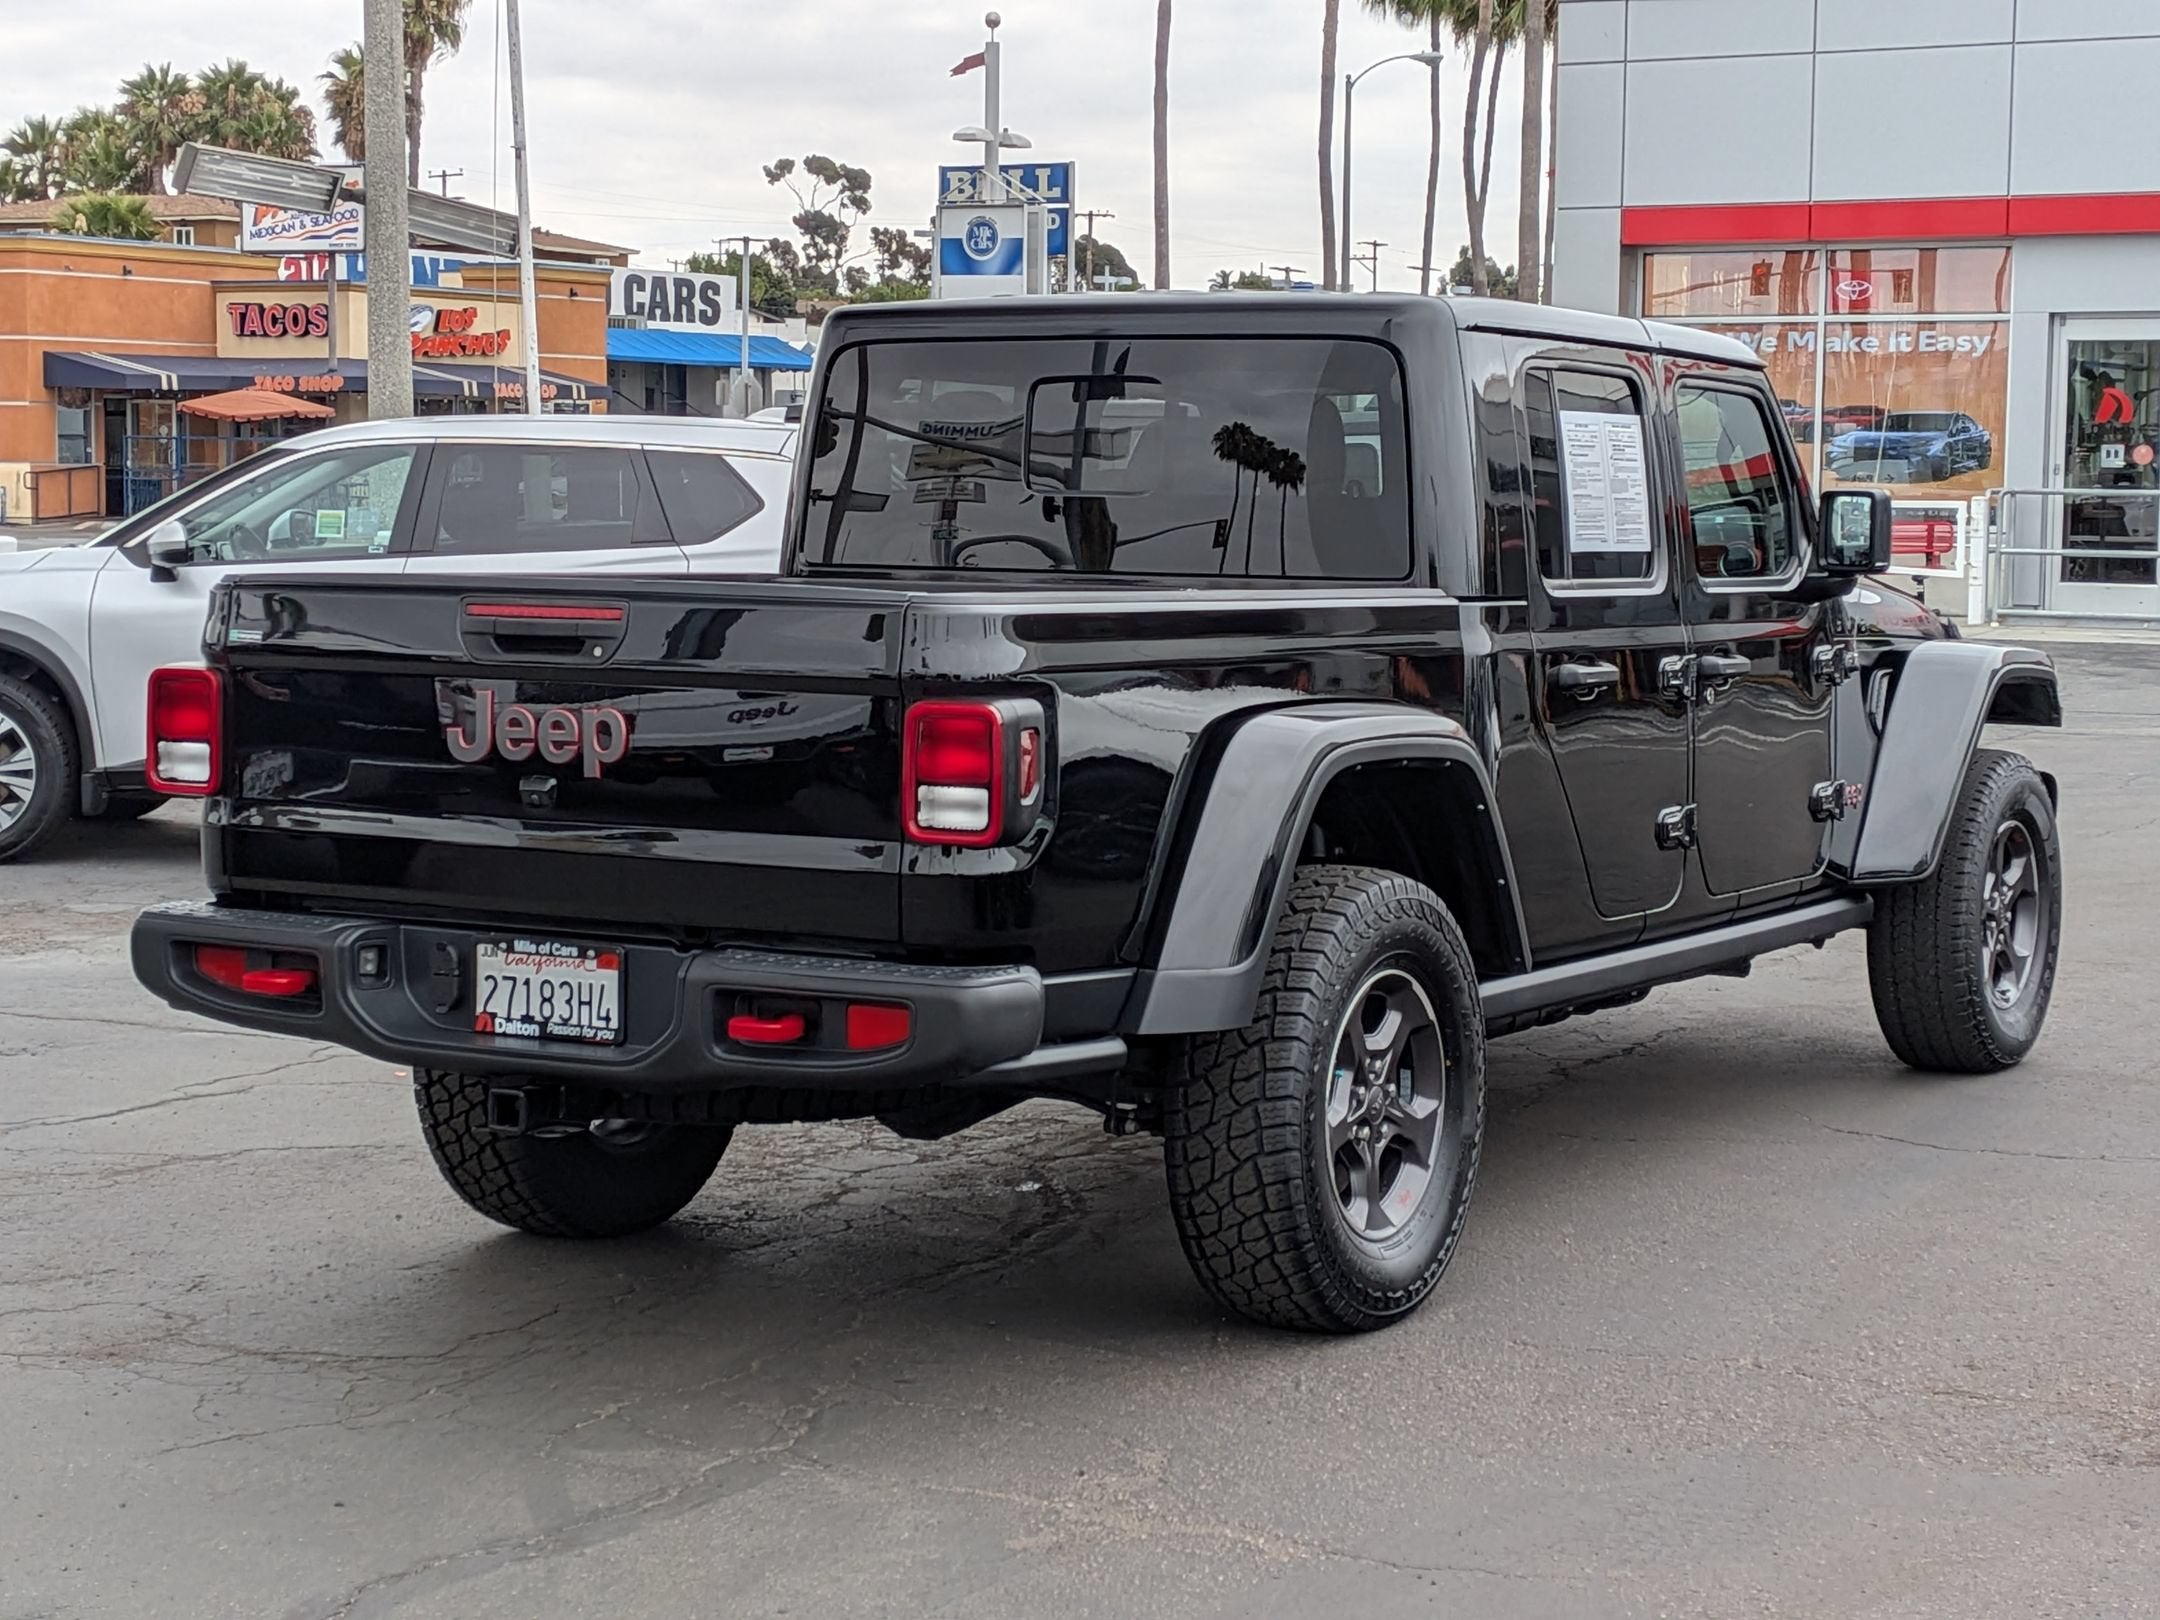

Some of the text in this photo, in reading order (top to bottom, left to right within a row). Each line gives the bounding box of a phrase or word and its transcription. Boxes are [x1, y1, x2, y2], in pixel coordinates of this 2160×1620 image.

[249, 220, 296, 240] MEXICAN
[299, 218, 307, 230] &
[624, 273, 721, 326] CARS
[227, 303, 328, 337] TACOS
[434, 306, 478, 333] LOS
[410, 329, 511, 358] PANCHOS
[1787, 331, 1879, 353] Make
[1889, 331, 1912, 353] It
[1919, 331, 1991, 357] Easy
[254, 375, 344, 392] TACO SHOP
[493, 382, 524, 398] TACO
[446, 690, 630, 779] Jeep
[514, 940, 578, 957] Mile of Cars
[504, 952, 597, 975] California
[484, 975, 612, 1028] 27183H4
[494, 1018, 616, 1041] Dalton Passion for you
